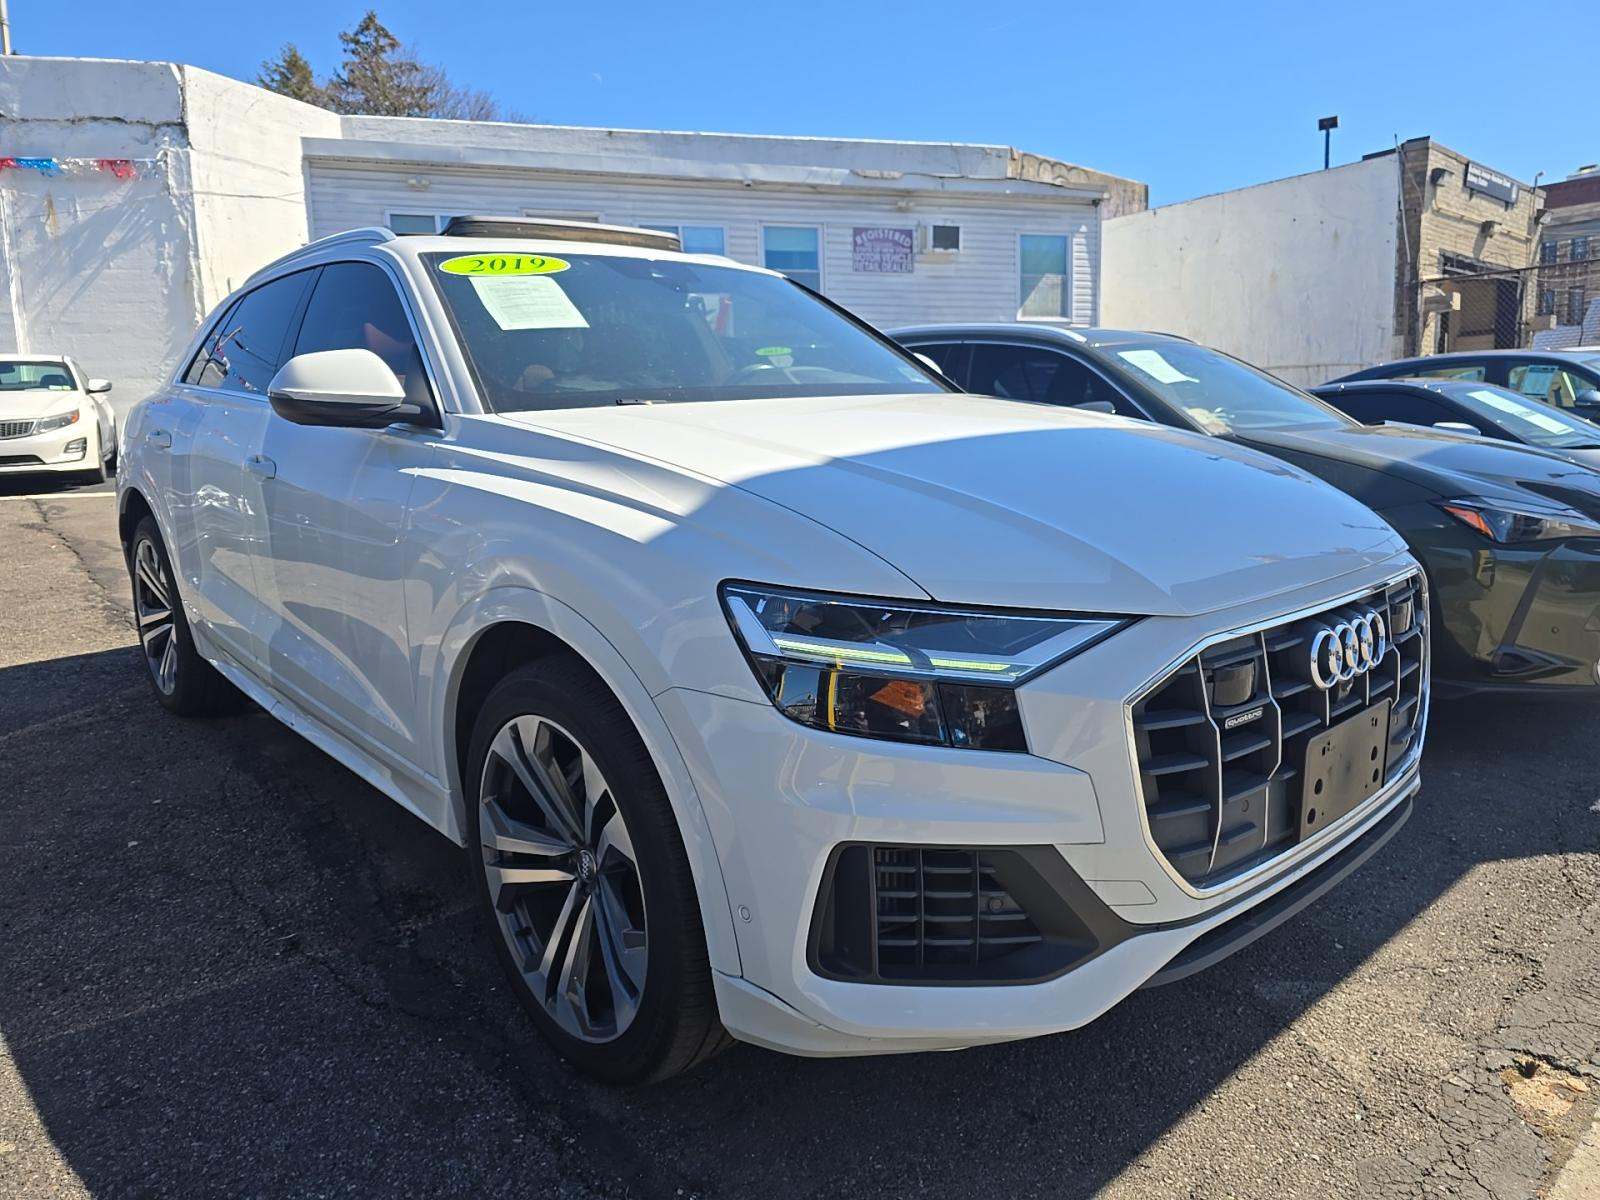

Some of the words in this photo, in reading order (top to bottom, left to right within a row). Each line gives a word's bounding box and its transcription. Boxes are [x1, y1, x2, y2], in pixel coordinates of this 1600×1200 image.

[855, 229, 911, 247] REGISTERED
[468, 258, 546, 272] 2019
[1225, 709, 1263, 728] quattro
